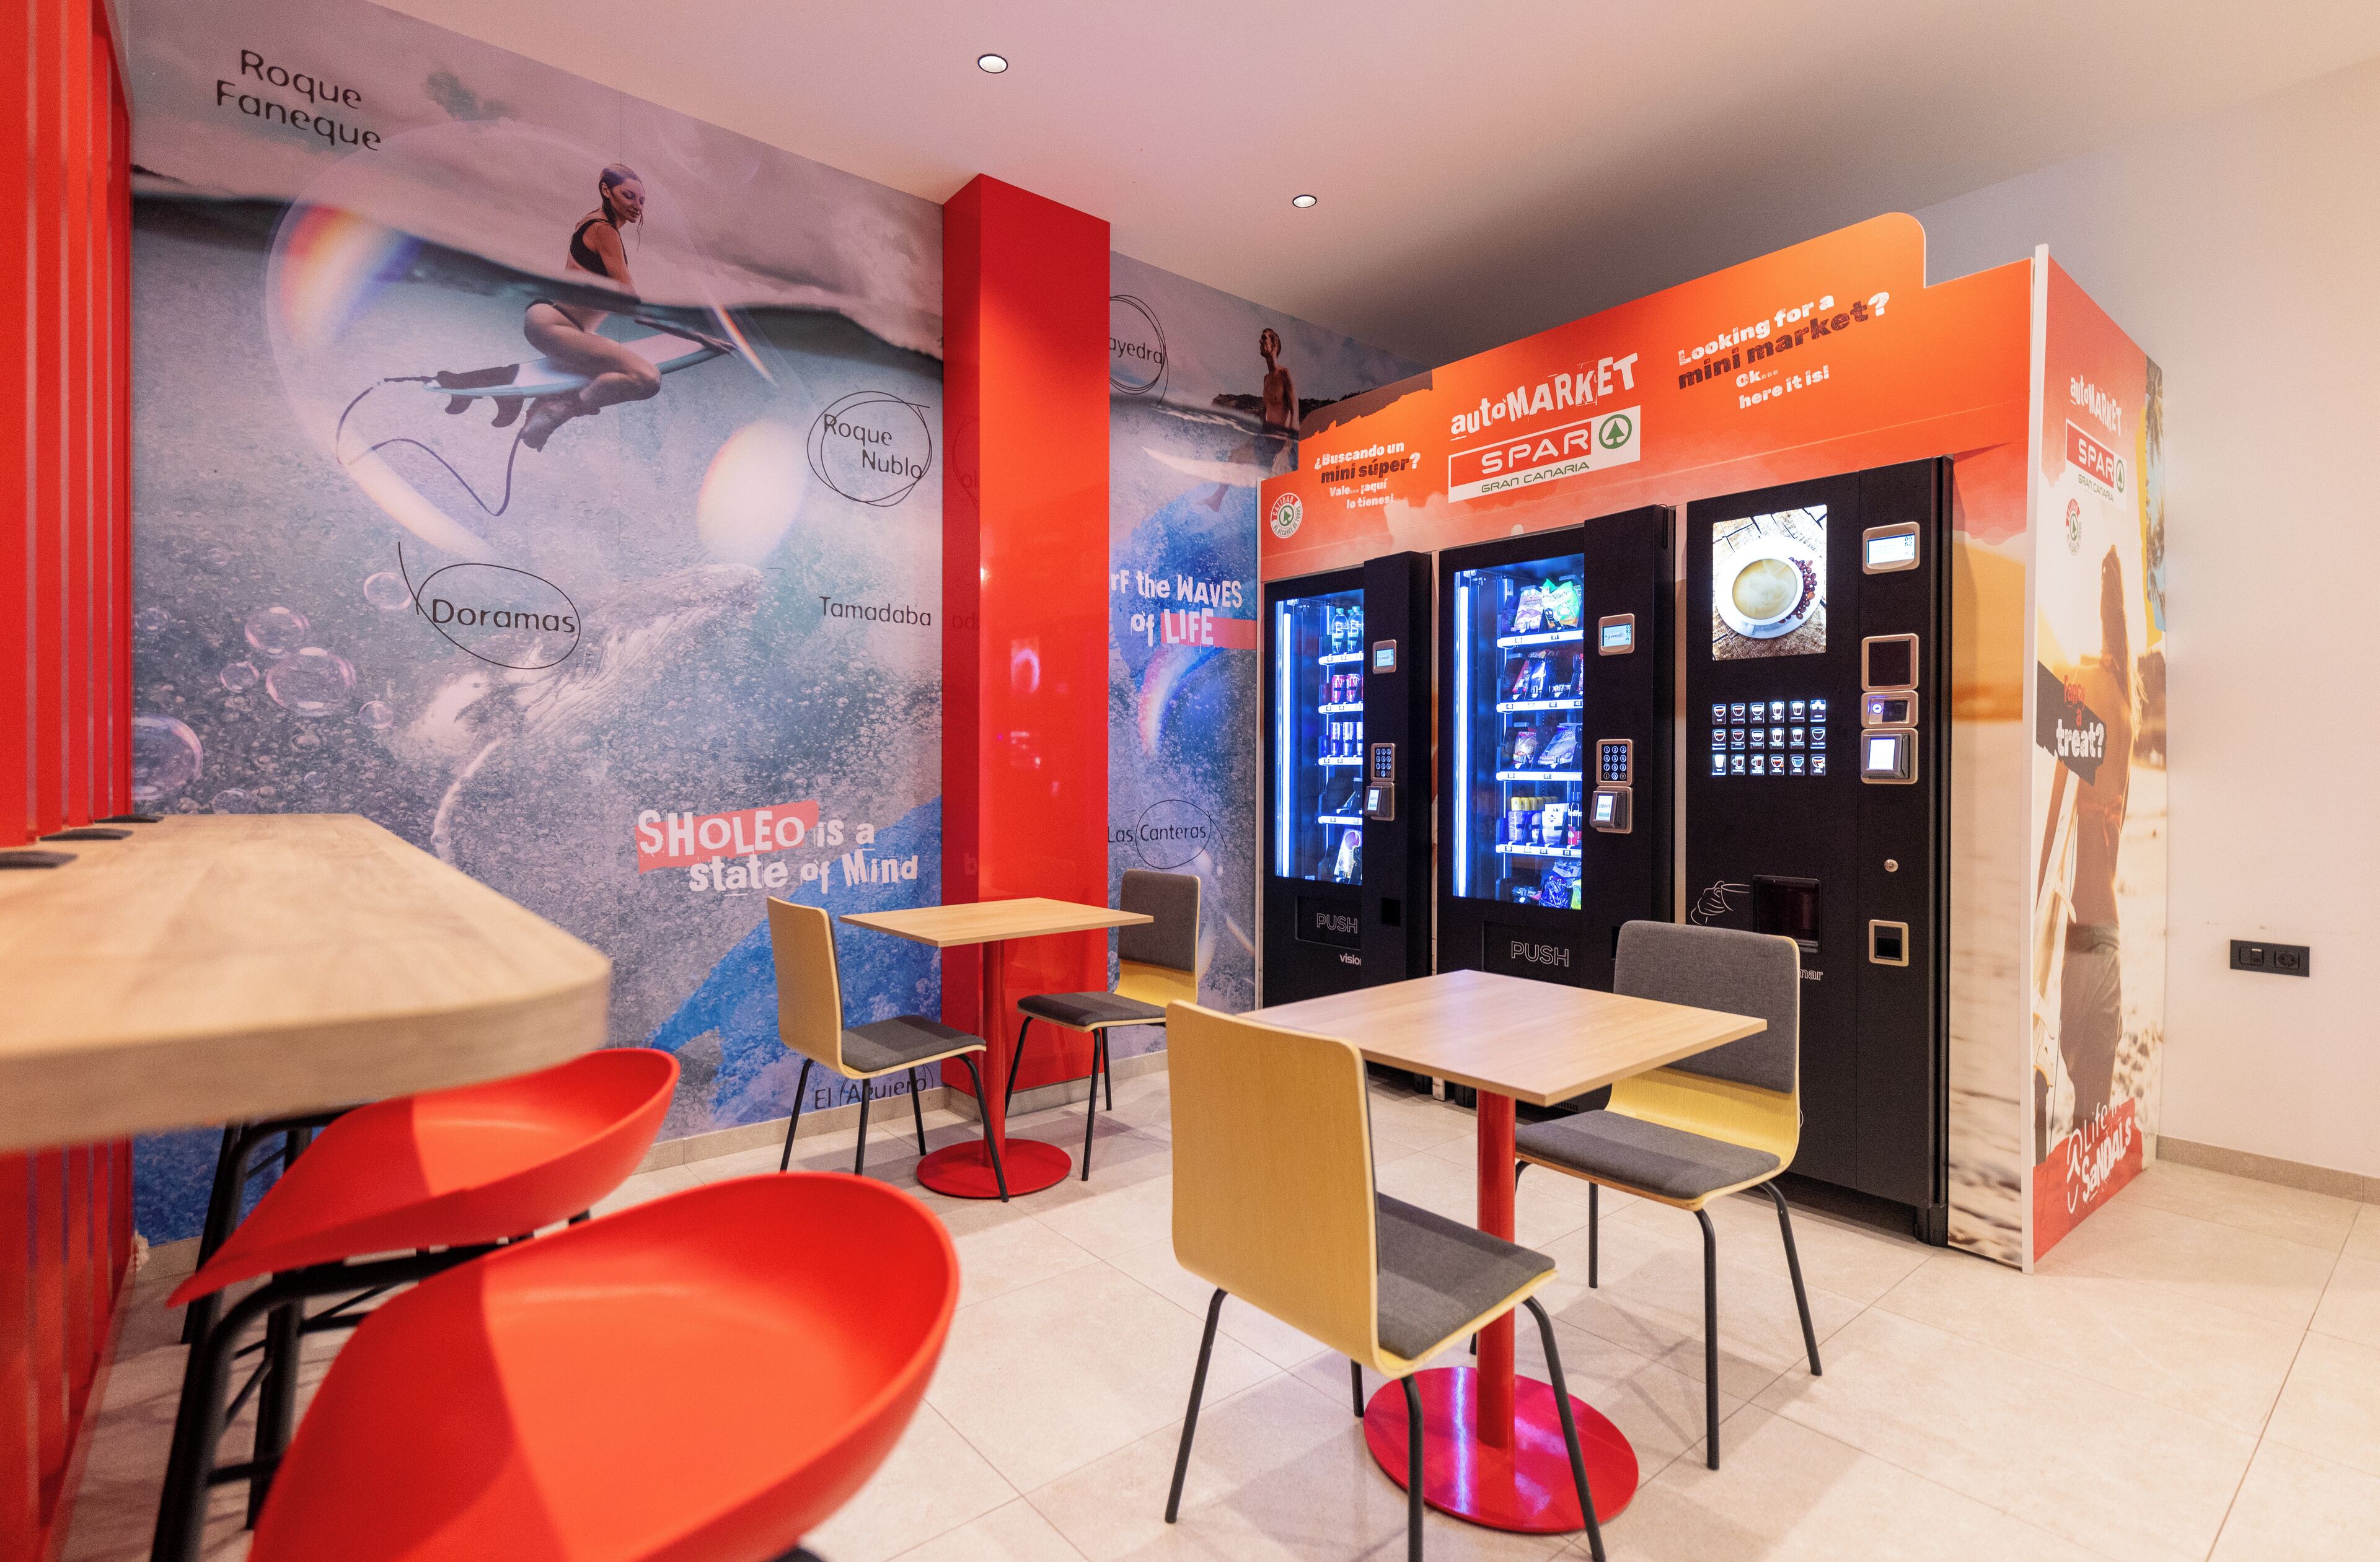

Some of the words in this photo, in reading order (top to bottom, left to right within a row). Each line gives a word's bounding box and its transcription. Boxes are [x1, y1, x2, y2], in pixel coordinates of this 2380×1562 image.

[240, 49, 361, 110] Roque
[216, 79, 382, 151] Faneque
[1678, 319, 1771, 366] Looking
[1774, 302, 1814, 327] for
[1818, 295, 1835, 310] a
[1678, 347, 1740, 390] mini
[1747, 291, 1890, 364] market?
[1109, 337, 1163, 364] ayedra
[1739, 385, 1783, 410] here
[1786, 375, 1802, 392] it
[1806, 364, 1830, 385] is!
[824, 413, 892, 447] Roque
[862, 449, 923, 480] Nublo
[1314, 444, 1385, 470] ¿Buscando
[1387, 442, 1404, 454] un
[1321, 462, 1355, 483] mini
[1358, 452, 1421, 479] súper?
[1481, 429, 1589, 475] SPAR
[2078, 437, 2114, 483] SPAR
[1329, 485, 1359, 497] Vale...
[1481, 477, 1519, 493] GRAN
[1523, 462, 1590, 483] CANARIA
[1272, 495, 1294, 516] CALIDAD
[1346, 499, 1356, 509] lo
[1357, 493, 1394, 507] tienes!
[1277, 527, 1294, 535] ALCANCE
[1135, 571, 1171, 599] the
[1178, 574, 1243, 608] WAVES
[433, 599, 575, 633] Doramas
[819, 596, 931, 626] Tamadaba
[1131, 612, 1154, 647] of
[1164, 608, 1214, 646] LIFE
[2056, 719, 2104, 758] treat?
[638, 809, 805, 857] SHOLEO
[856, 822, 874, 845] a
[1108, 825, 1134, 843] Las
[1140, 824, 1206, 841] Canteras
[689, 854, 788, 892] state
[801, 860, 831, 894] of
[841, 852, 919, 887] Mind
[1317, 913, 1358, 934] PUSH
[1511, 941, 1569, 967] PUSH
[1800, 968, 1823, 981] mar
[814, 1087, 831, 1110] El
